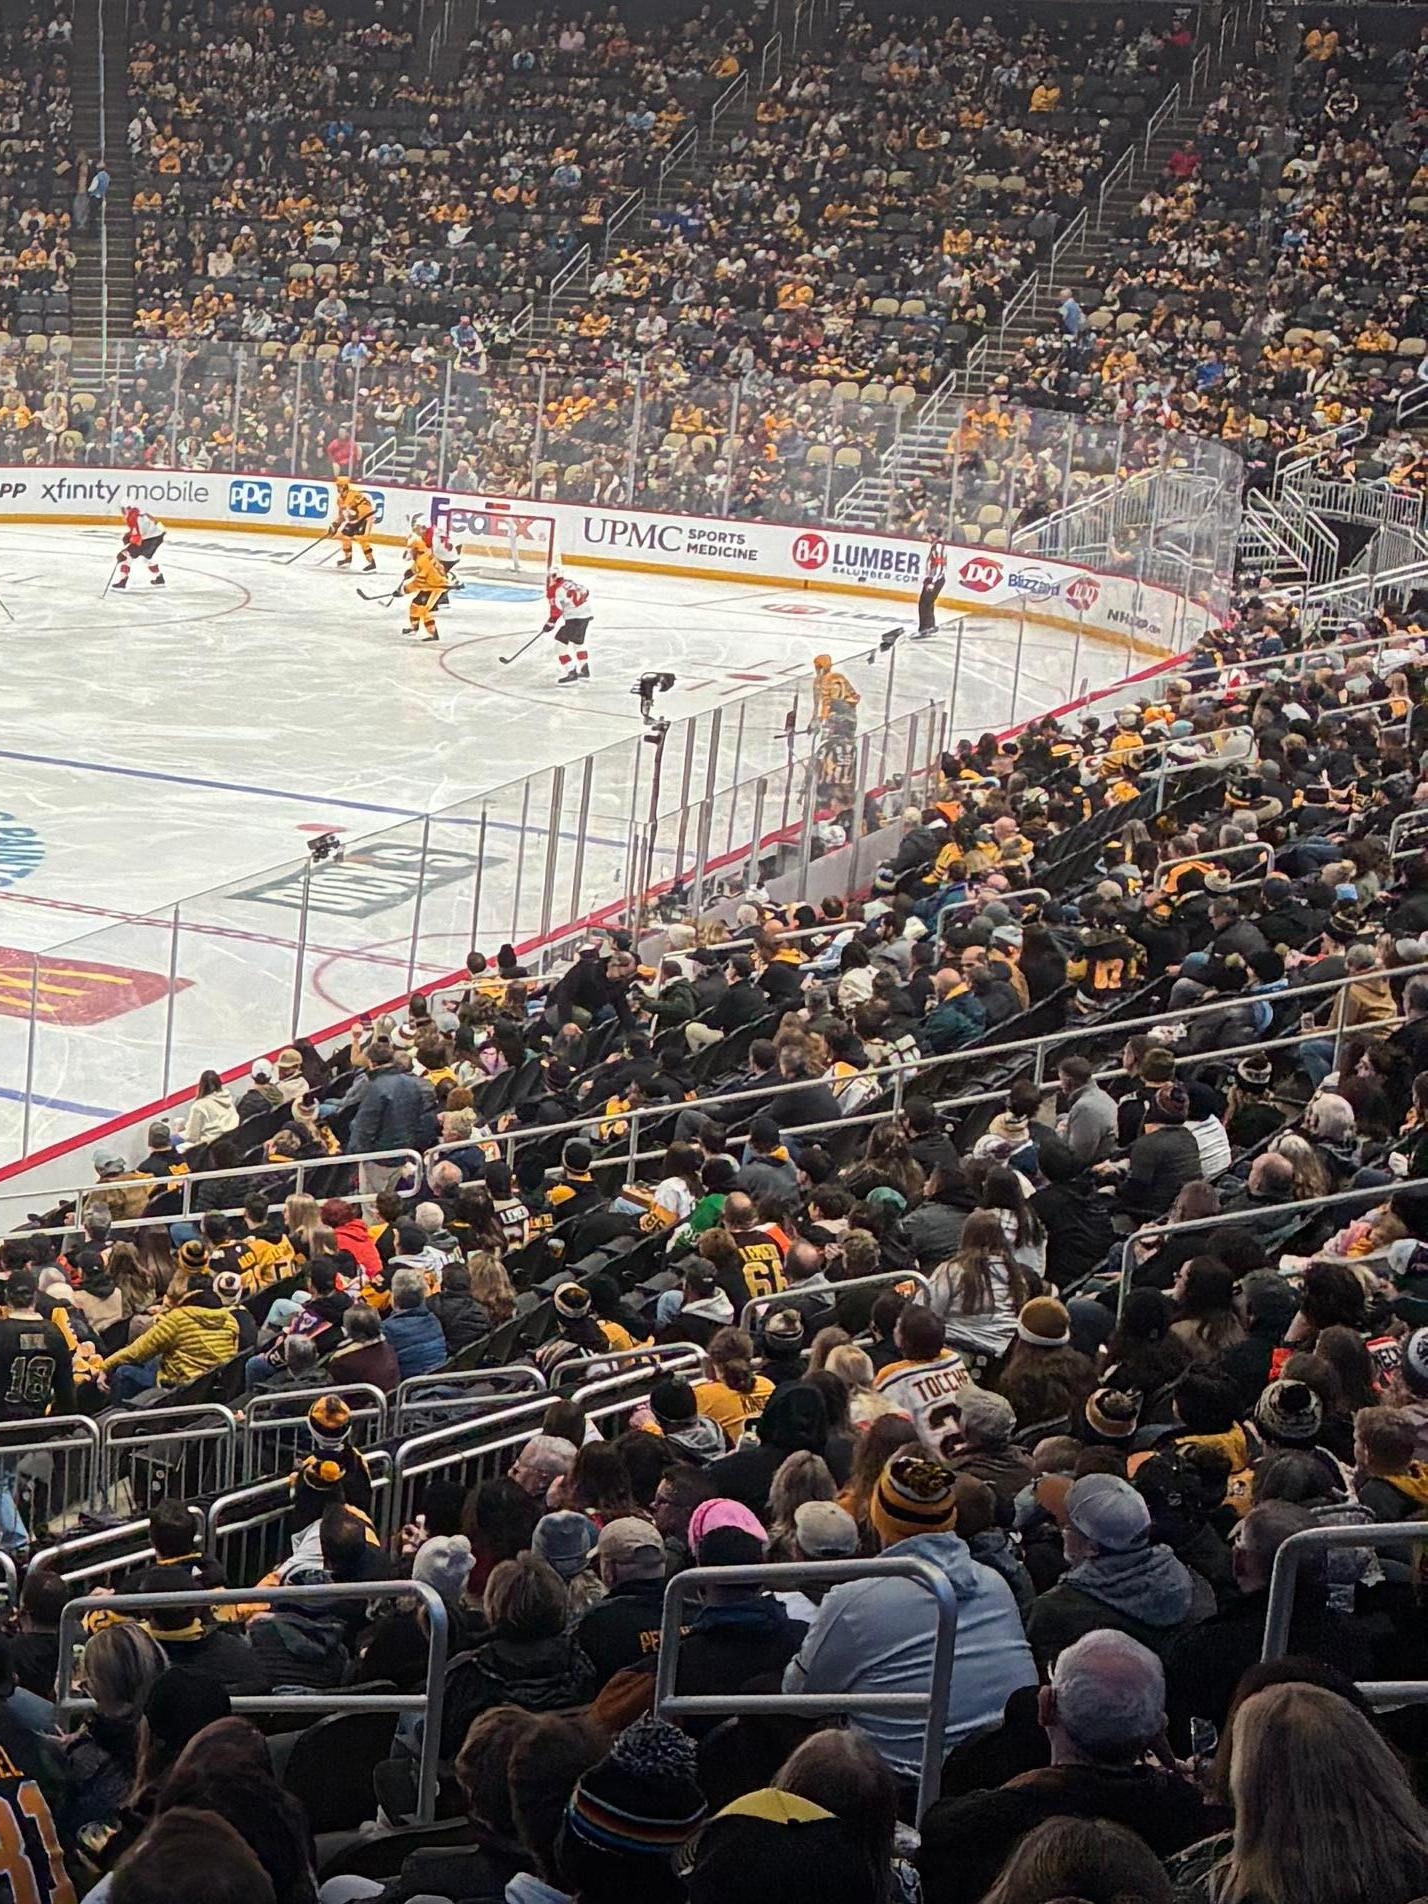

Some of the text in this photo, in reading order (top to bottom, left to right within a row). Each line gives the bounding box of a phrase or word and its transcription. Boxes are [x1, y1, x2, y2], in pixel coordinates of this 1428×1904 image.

[42, 478, 209, 504] xfinity mobile
[584, 517, 746, 552] UPMC SPORTS
[686, 543, 759, 562] MEDICINE
[794, 539, 921, 575] 84 LUMBER
[967, 563, 996, 587] DQ
